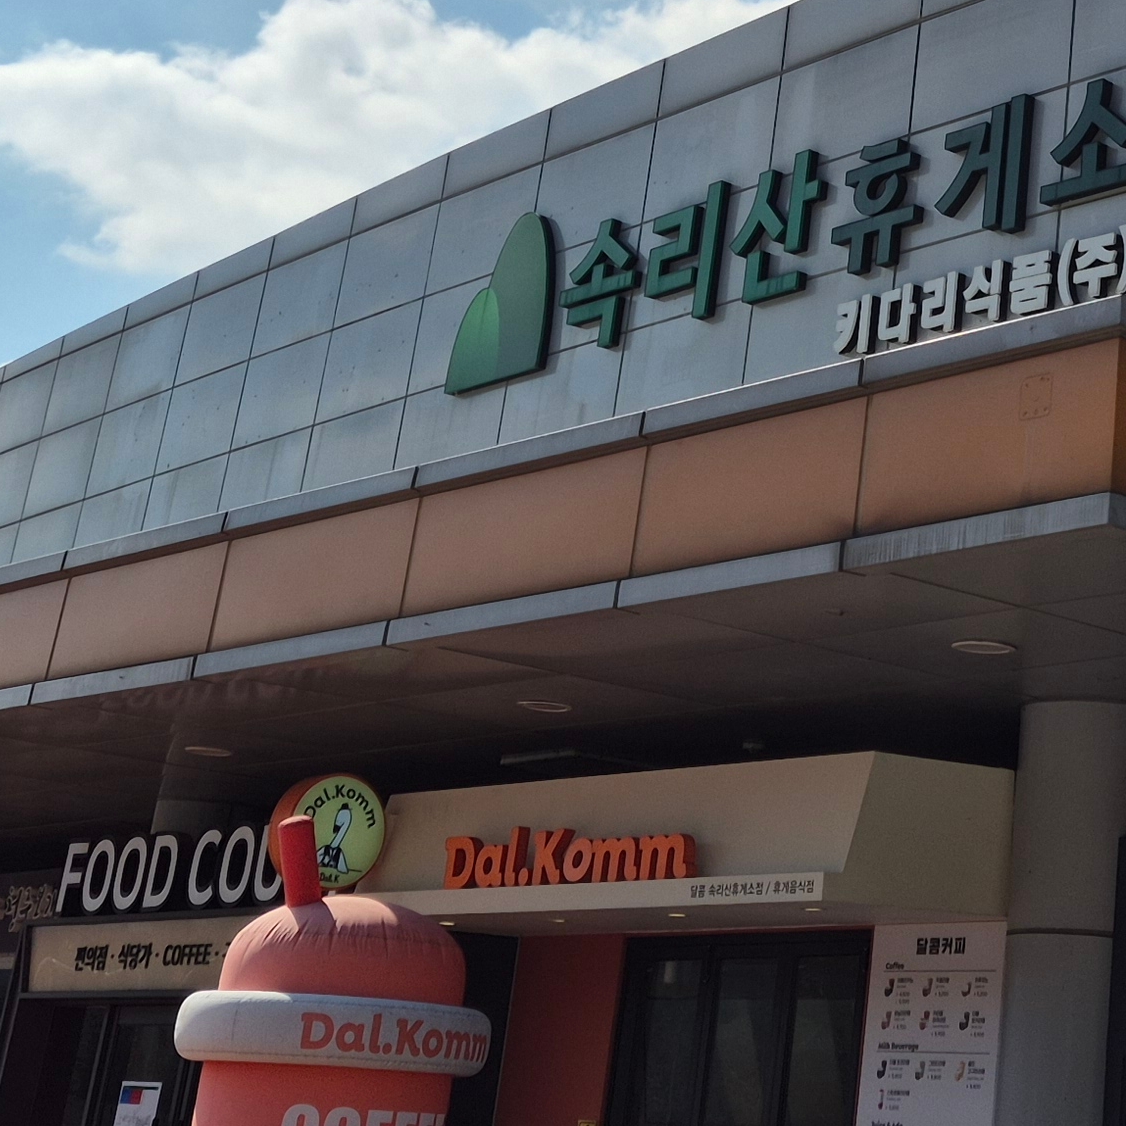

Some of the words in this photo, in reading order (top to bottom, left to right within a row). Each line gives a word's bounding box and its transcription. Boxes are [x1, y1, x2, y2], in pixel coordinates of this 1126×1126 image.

[56, 834, 179, 913] FOOD
[443, 826, 694, 889] Dal.Komm
[75, 944, 109, 971] 편의점
[118, 942, 153, 969] 식당가
[163, 943, 213, 967] COFFEE
[915, 937, 966, 955] 달콤커피
[300, 1012, 487, 1063] Dal.Komm
